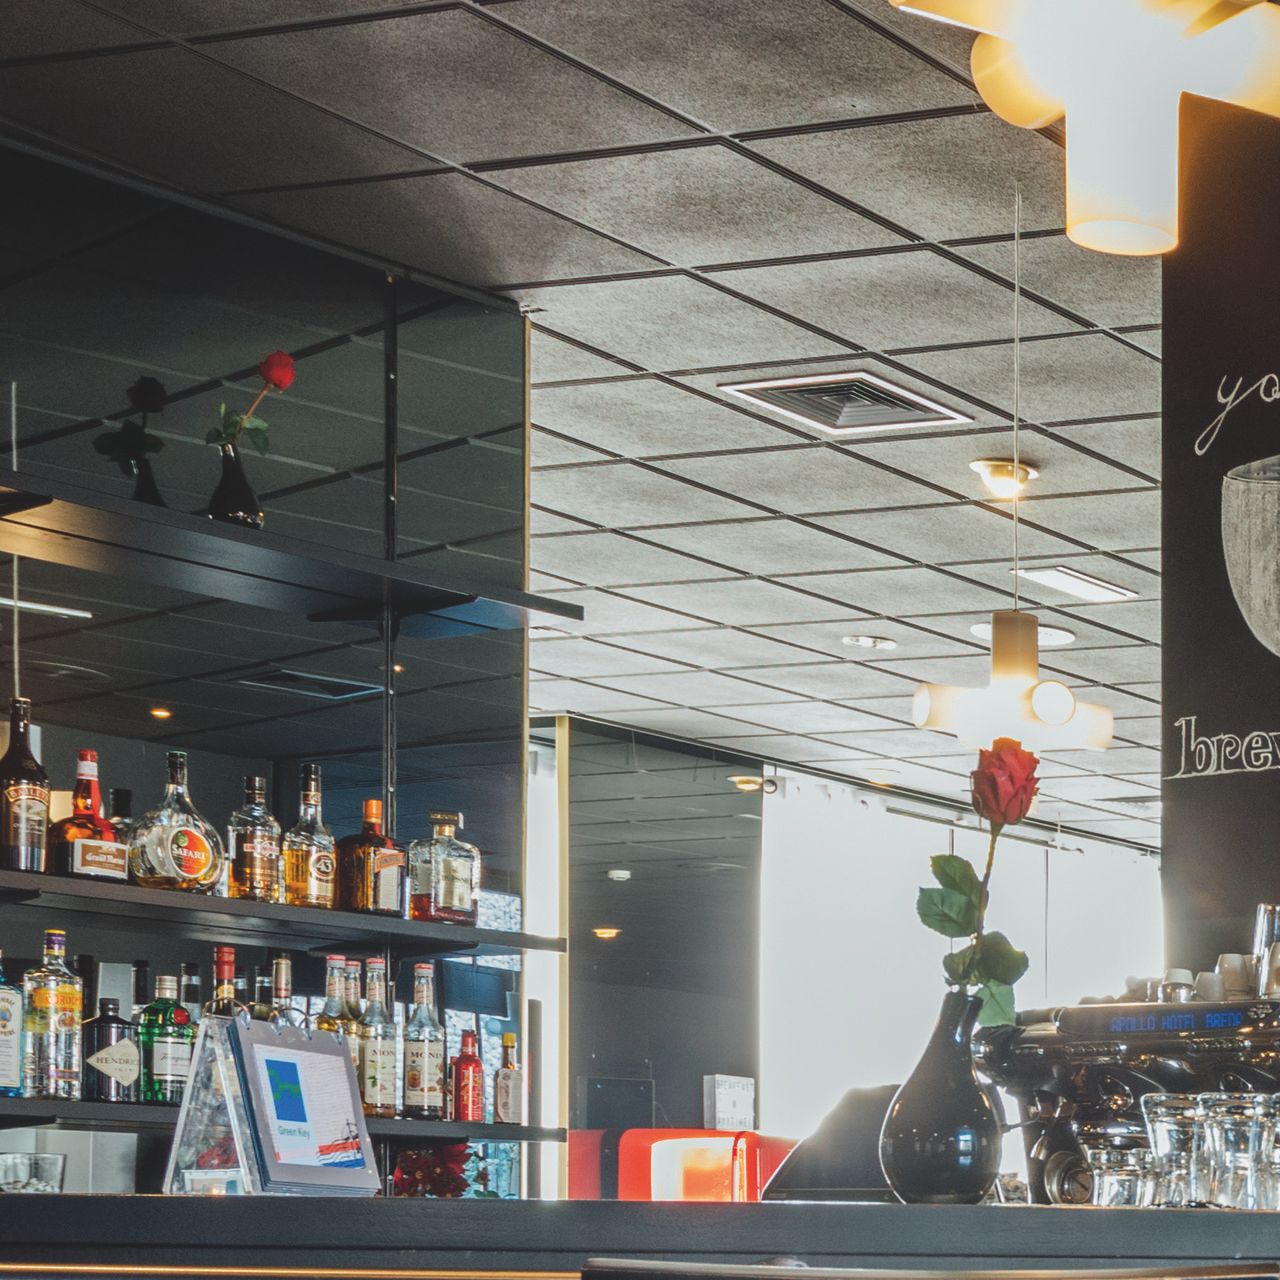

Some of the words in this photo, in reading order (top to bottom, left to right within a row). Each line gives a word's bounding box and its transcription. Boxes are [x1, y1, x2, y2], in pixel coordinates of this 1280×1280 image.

[9, 786, 49, 801] BAILEY
[172, 844, 206, 860] SAFARI
[316, 859, 333, 874] 43
[1110, 1015, 1156, 1032] APOLLO
[1160, 1014, 1195, 1031] HOTEL
[96, 1056, 139, 1066] HENDRI
[278, 1125, 297, 1136] Green
[298, 1129, 310, 1140] Key
